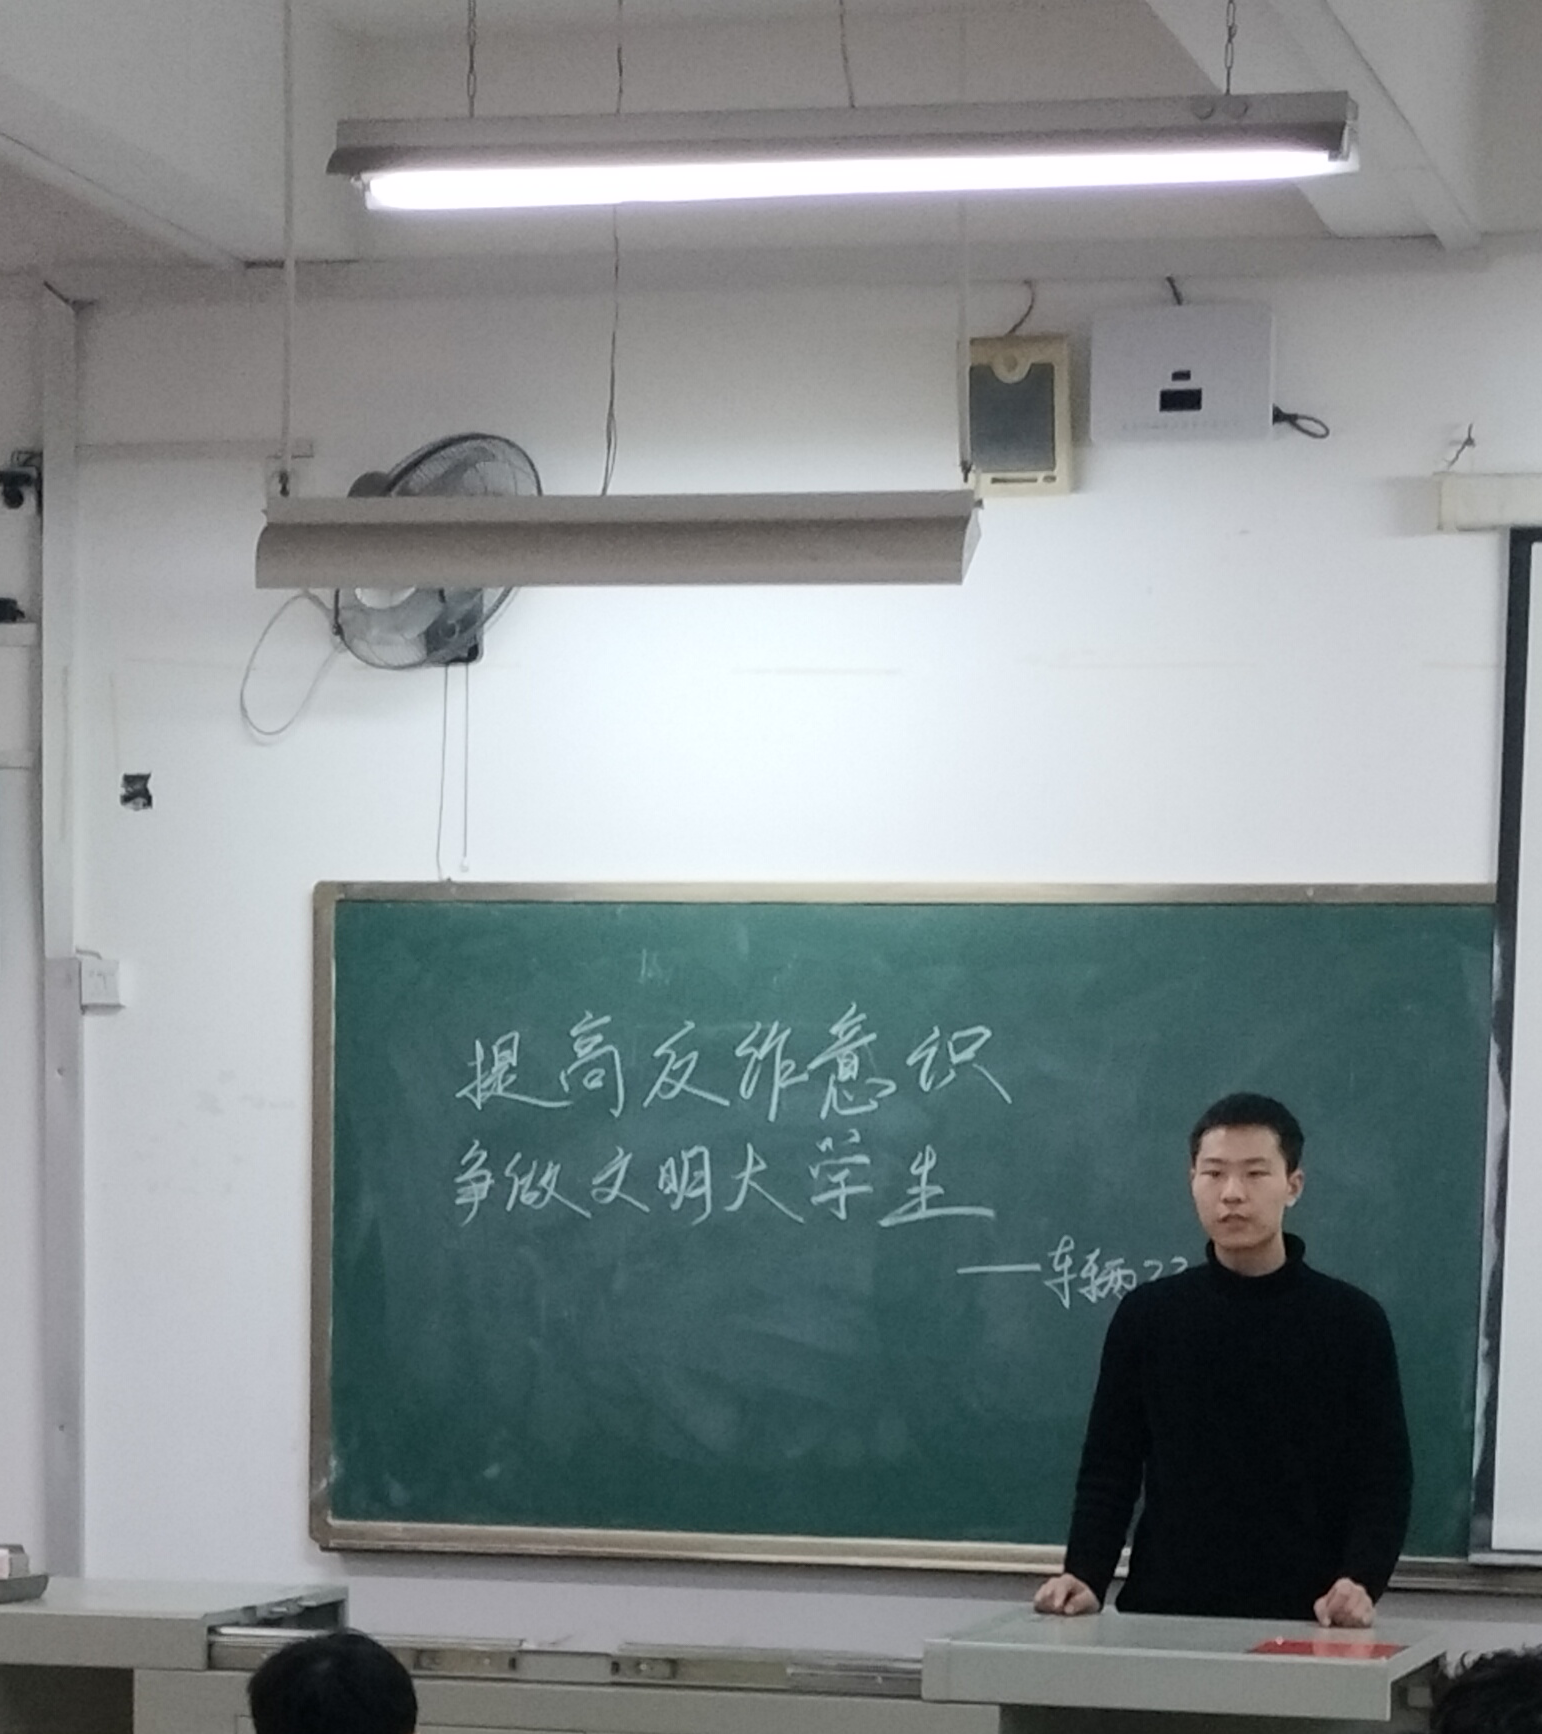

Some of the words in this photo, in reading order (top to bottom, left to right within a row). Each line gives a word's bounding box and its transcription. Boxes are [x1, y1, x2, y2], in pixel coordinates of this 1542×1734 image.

[454, 1129, 995, 1227] 争做文明大学生
